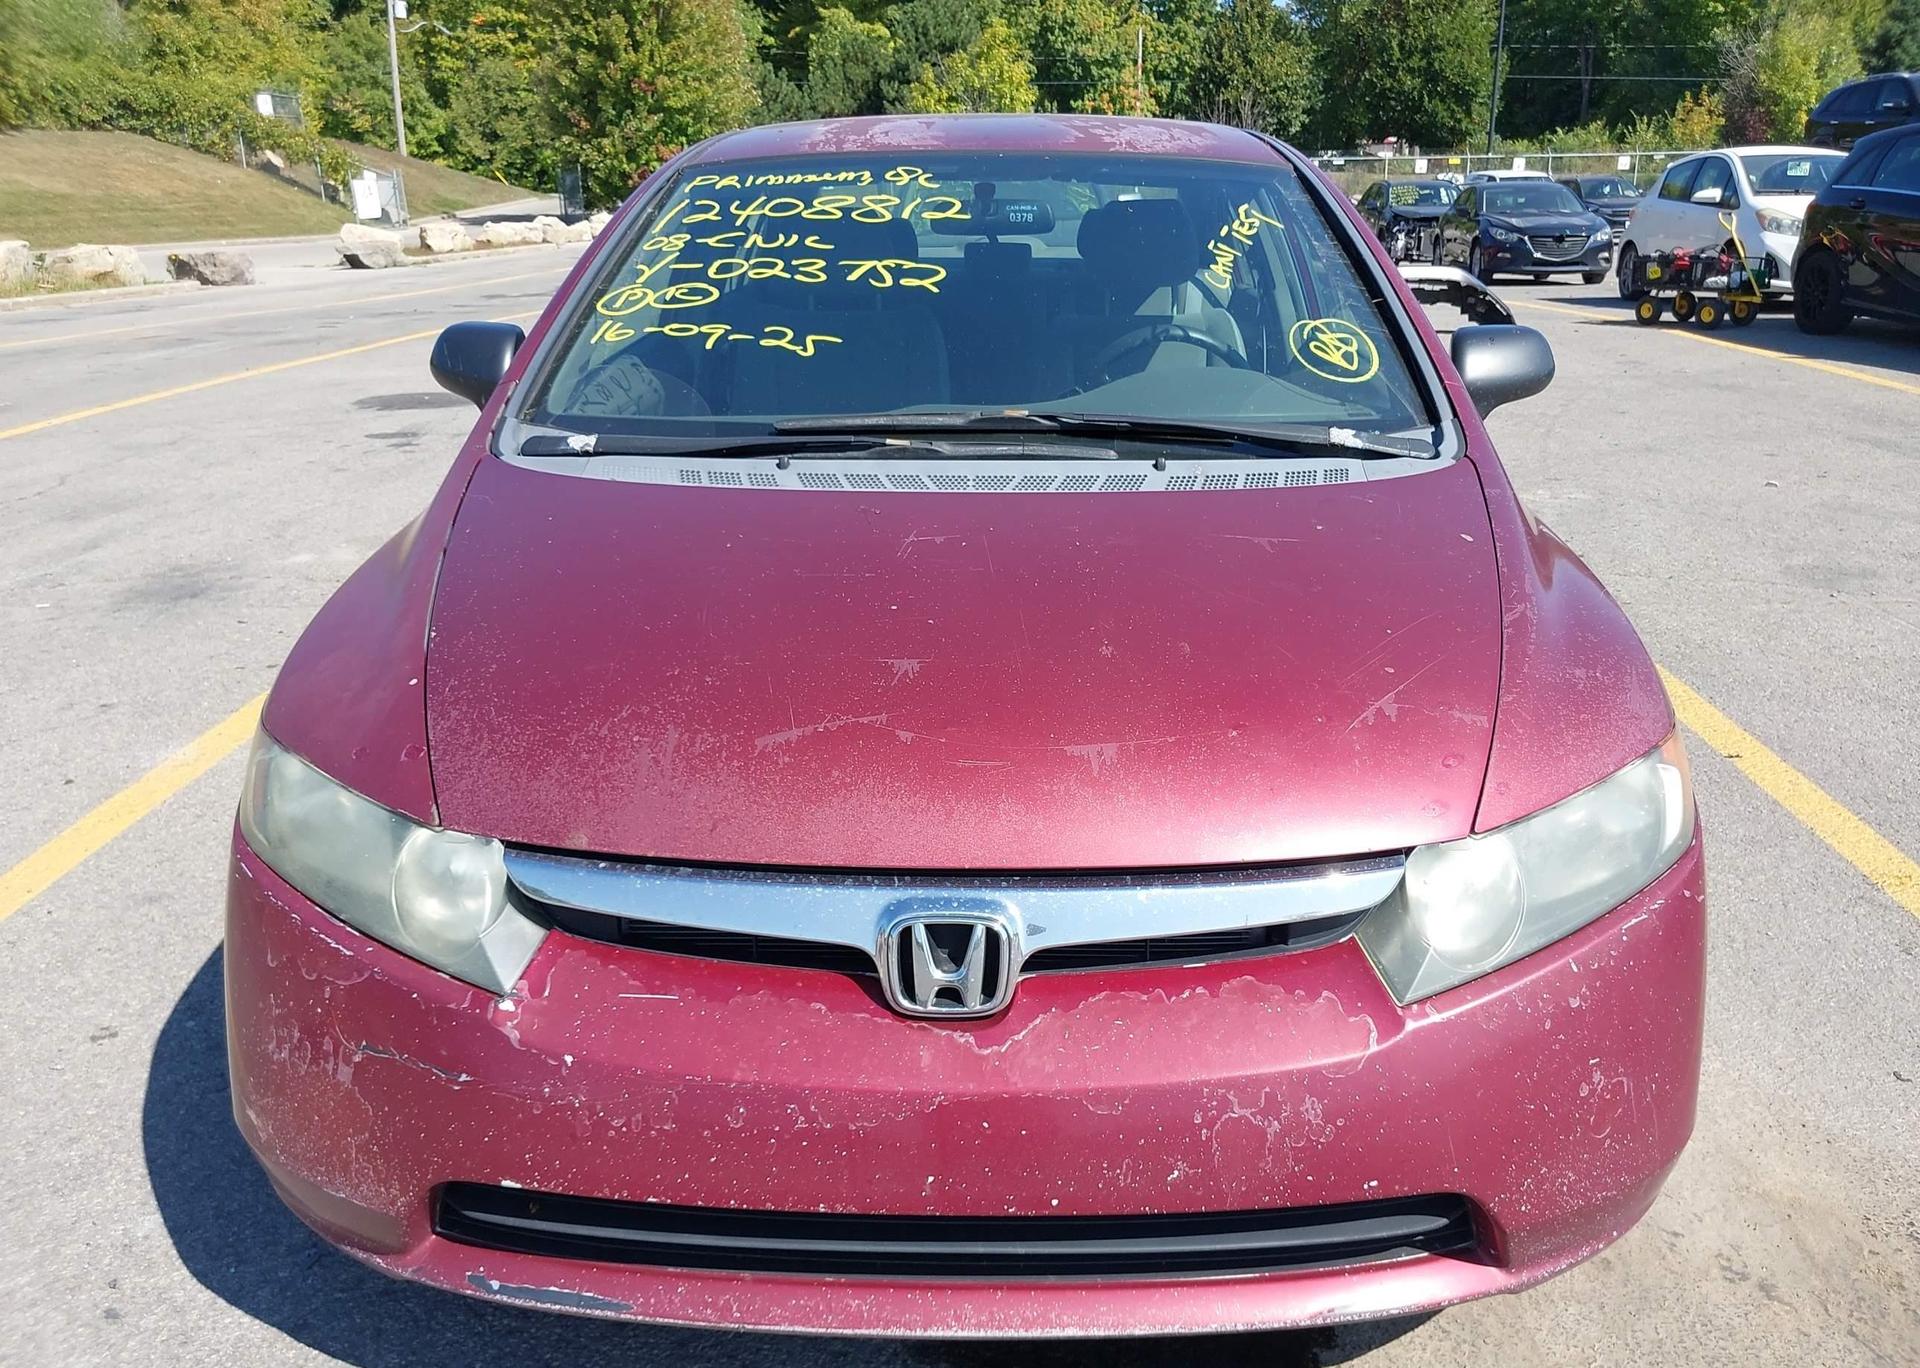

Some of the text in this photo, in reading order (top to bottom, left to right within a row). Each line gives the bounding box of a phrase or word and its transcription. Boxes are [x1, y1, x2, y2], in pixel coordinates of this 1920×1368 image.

[652, 194, 971, 234] 12408812
[1010, 212, 1034, 222] 0378
[590, 319, 843, 357] 16-09-25
